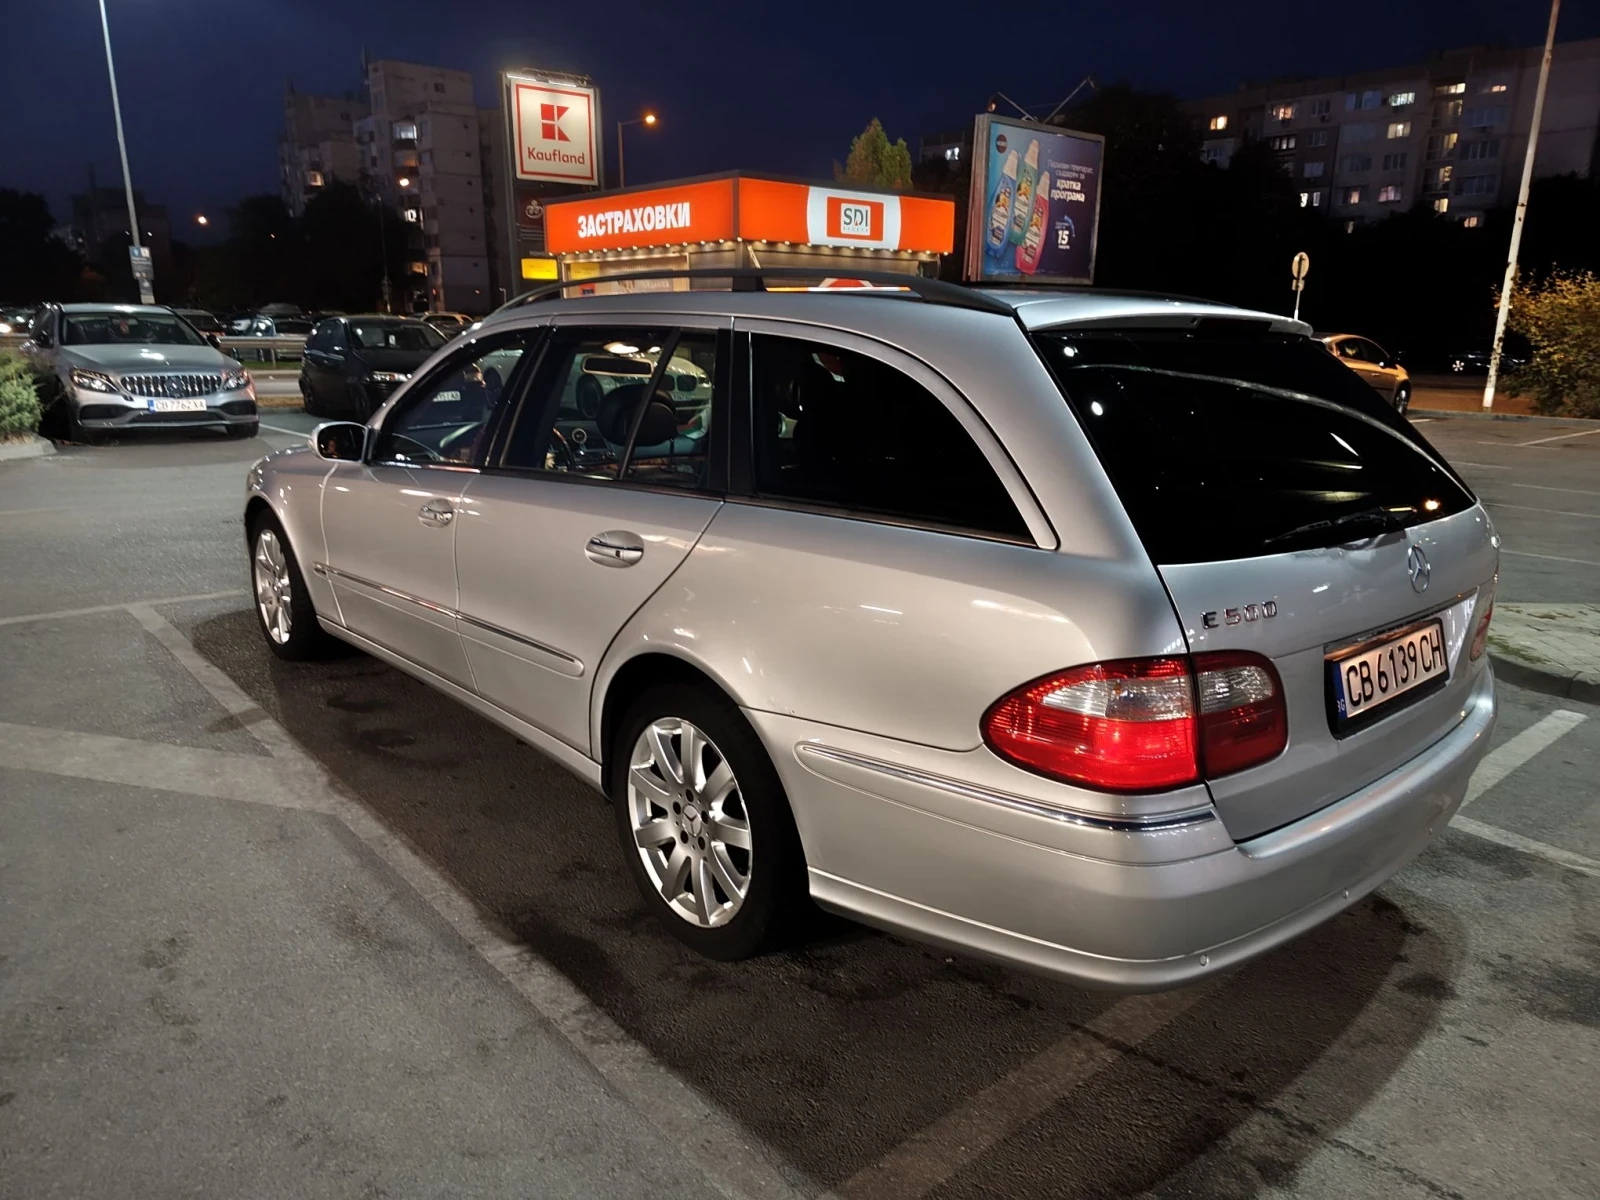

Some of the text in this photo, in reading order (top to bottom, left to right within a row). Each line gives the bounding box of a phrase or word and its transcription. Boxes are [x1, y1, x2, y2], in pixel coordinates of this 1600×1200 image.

[527, 146, 586, 165] Kaufland
[1056, 179, 1082, 191] кратка
[1050, 189, 1086, 202] програма
[577, 202, 691, 239] ЗАСТРАХОВКИ
[843, 207, 869, 227] SDI
[1058, 230, 1070, 245] 15
[1200, 601, 1278, 630] E 500
